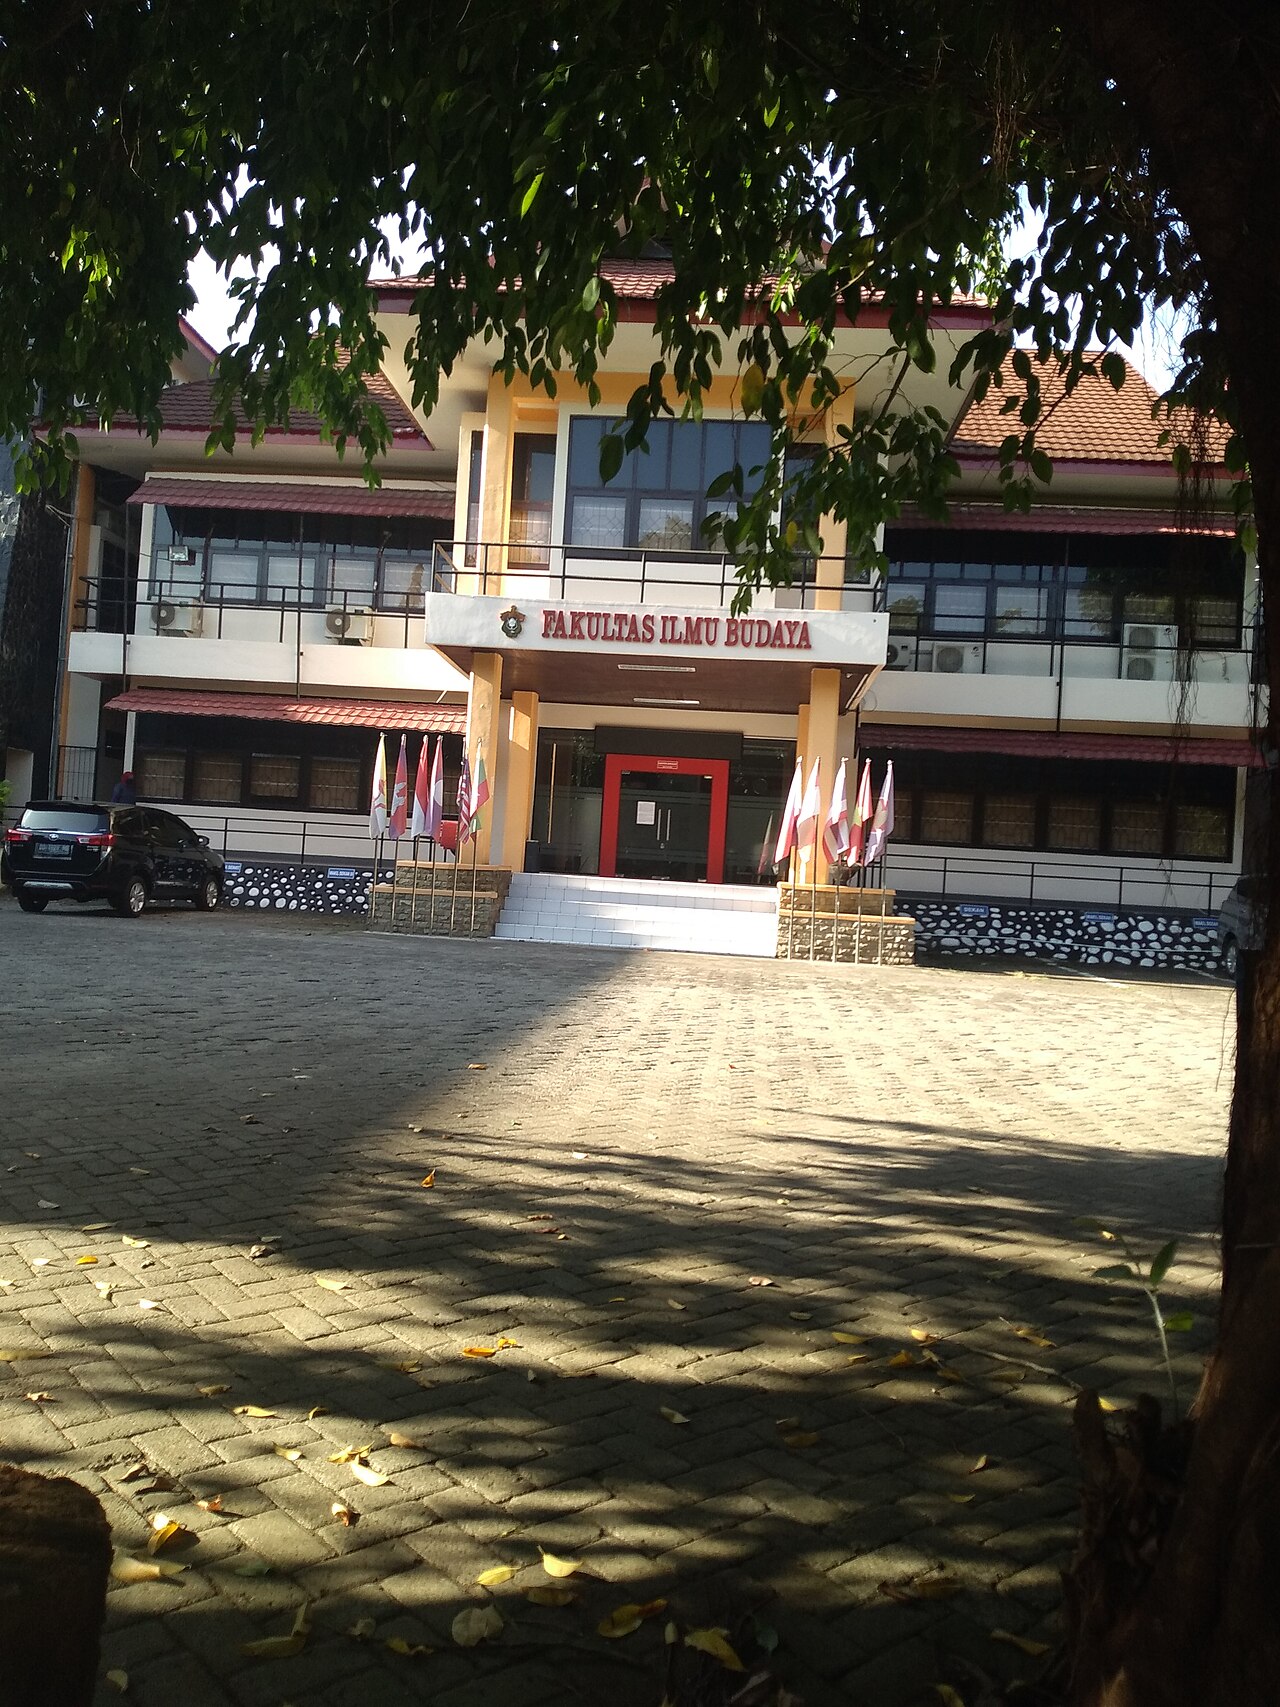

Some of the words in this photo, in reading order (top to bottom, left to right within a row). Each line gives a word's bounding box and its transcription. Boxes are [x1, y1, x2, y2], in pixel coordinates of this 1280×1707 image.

[542, 610, 655, 643] FAKULTAS
[659, 615, 719, 646] ILMU
[724, 618, 812, 649] BUDAYA
